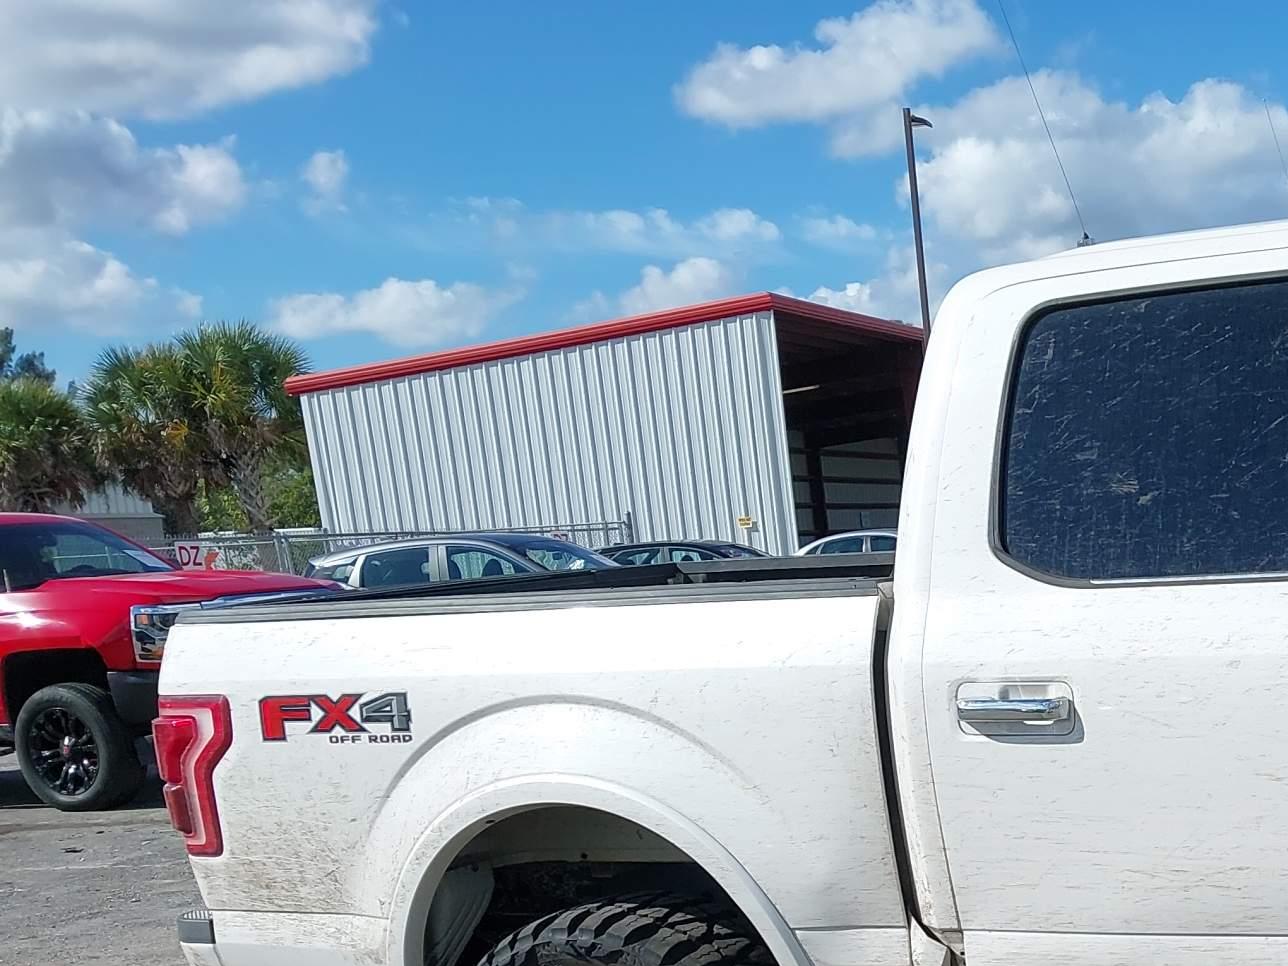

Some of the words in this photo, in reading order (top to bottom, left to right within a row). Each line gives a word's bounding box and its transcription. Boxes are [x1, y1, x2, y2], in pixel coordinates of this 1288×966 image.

[259, 692, 413, 742] FX4
[328, 735, 362, 744] OFF
[368, 734, 413, 744] ROAD
